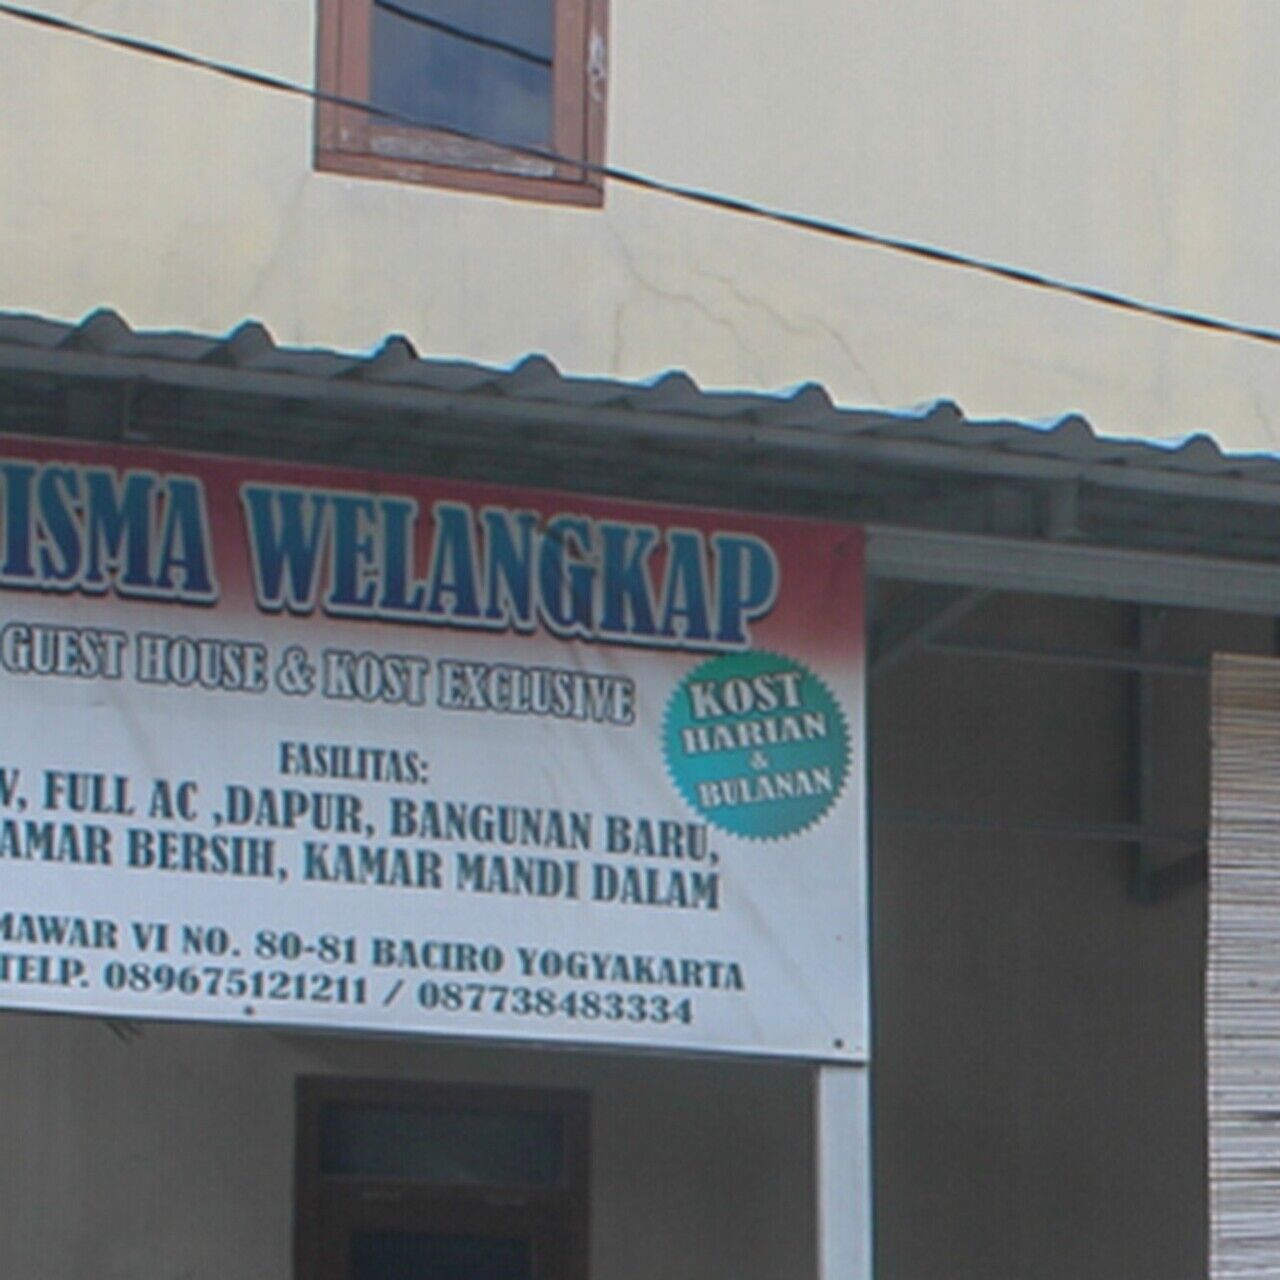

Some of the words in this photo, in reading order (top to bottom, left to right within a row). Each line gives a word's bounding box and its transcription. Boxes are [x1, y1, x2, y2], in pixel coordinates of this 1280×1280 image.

[241, 482, 779, 652] WELANGKAP
[2, 623, 127, 678] GUEST
[136, 633, 267, 691] HOUSE
[277, 647, 315, 695] &
[323, 649, 428, 705] KOST
[437, 659, 635, 724] EXCLUSIVE
[688, 671, 802, 721] KOST
[279, 741, 428, 785] FASILITAS:
[682, 712, 827, 754] HARIAN
[750, 750, 769, 770] &
[44, 770, 134, 816] FULL
[149, 779, 198, 821] AC
[390, 797, 592, 850] BANGUNAN
[606, 814, 719, 866] BARU,
[698, 766, 834, 808] BULANAN
[127, 828, 288, 883] BERSIH,
[302, 841, 442, 889] KAMAR
[456, 852, 579, 899] MANDI
[593, 863, 720, 910] DALAM
[0, 954, 90, 988] TELP.
[104, 962, 367, 1005] 089675121211
[383, 980, 404, 1007] /
[417, 981, 694, 1025] 087738483334
[131, 922, 168, 953] VI
[182, 925, 240, 957] NO.
[255, 931, 356, 965] 80-81
[371, 937, 504, 973] BACIRO
[516, 948, 744, 991] YOGYAKARTA
